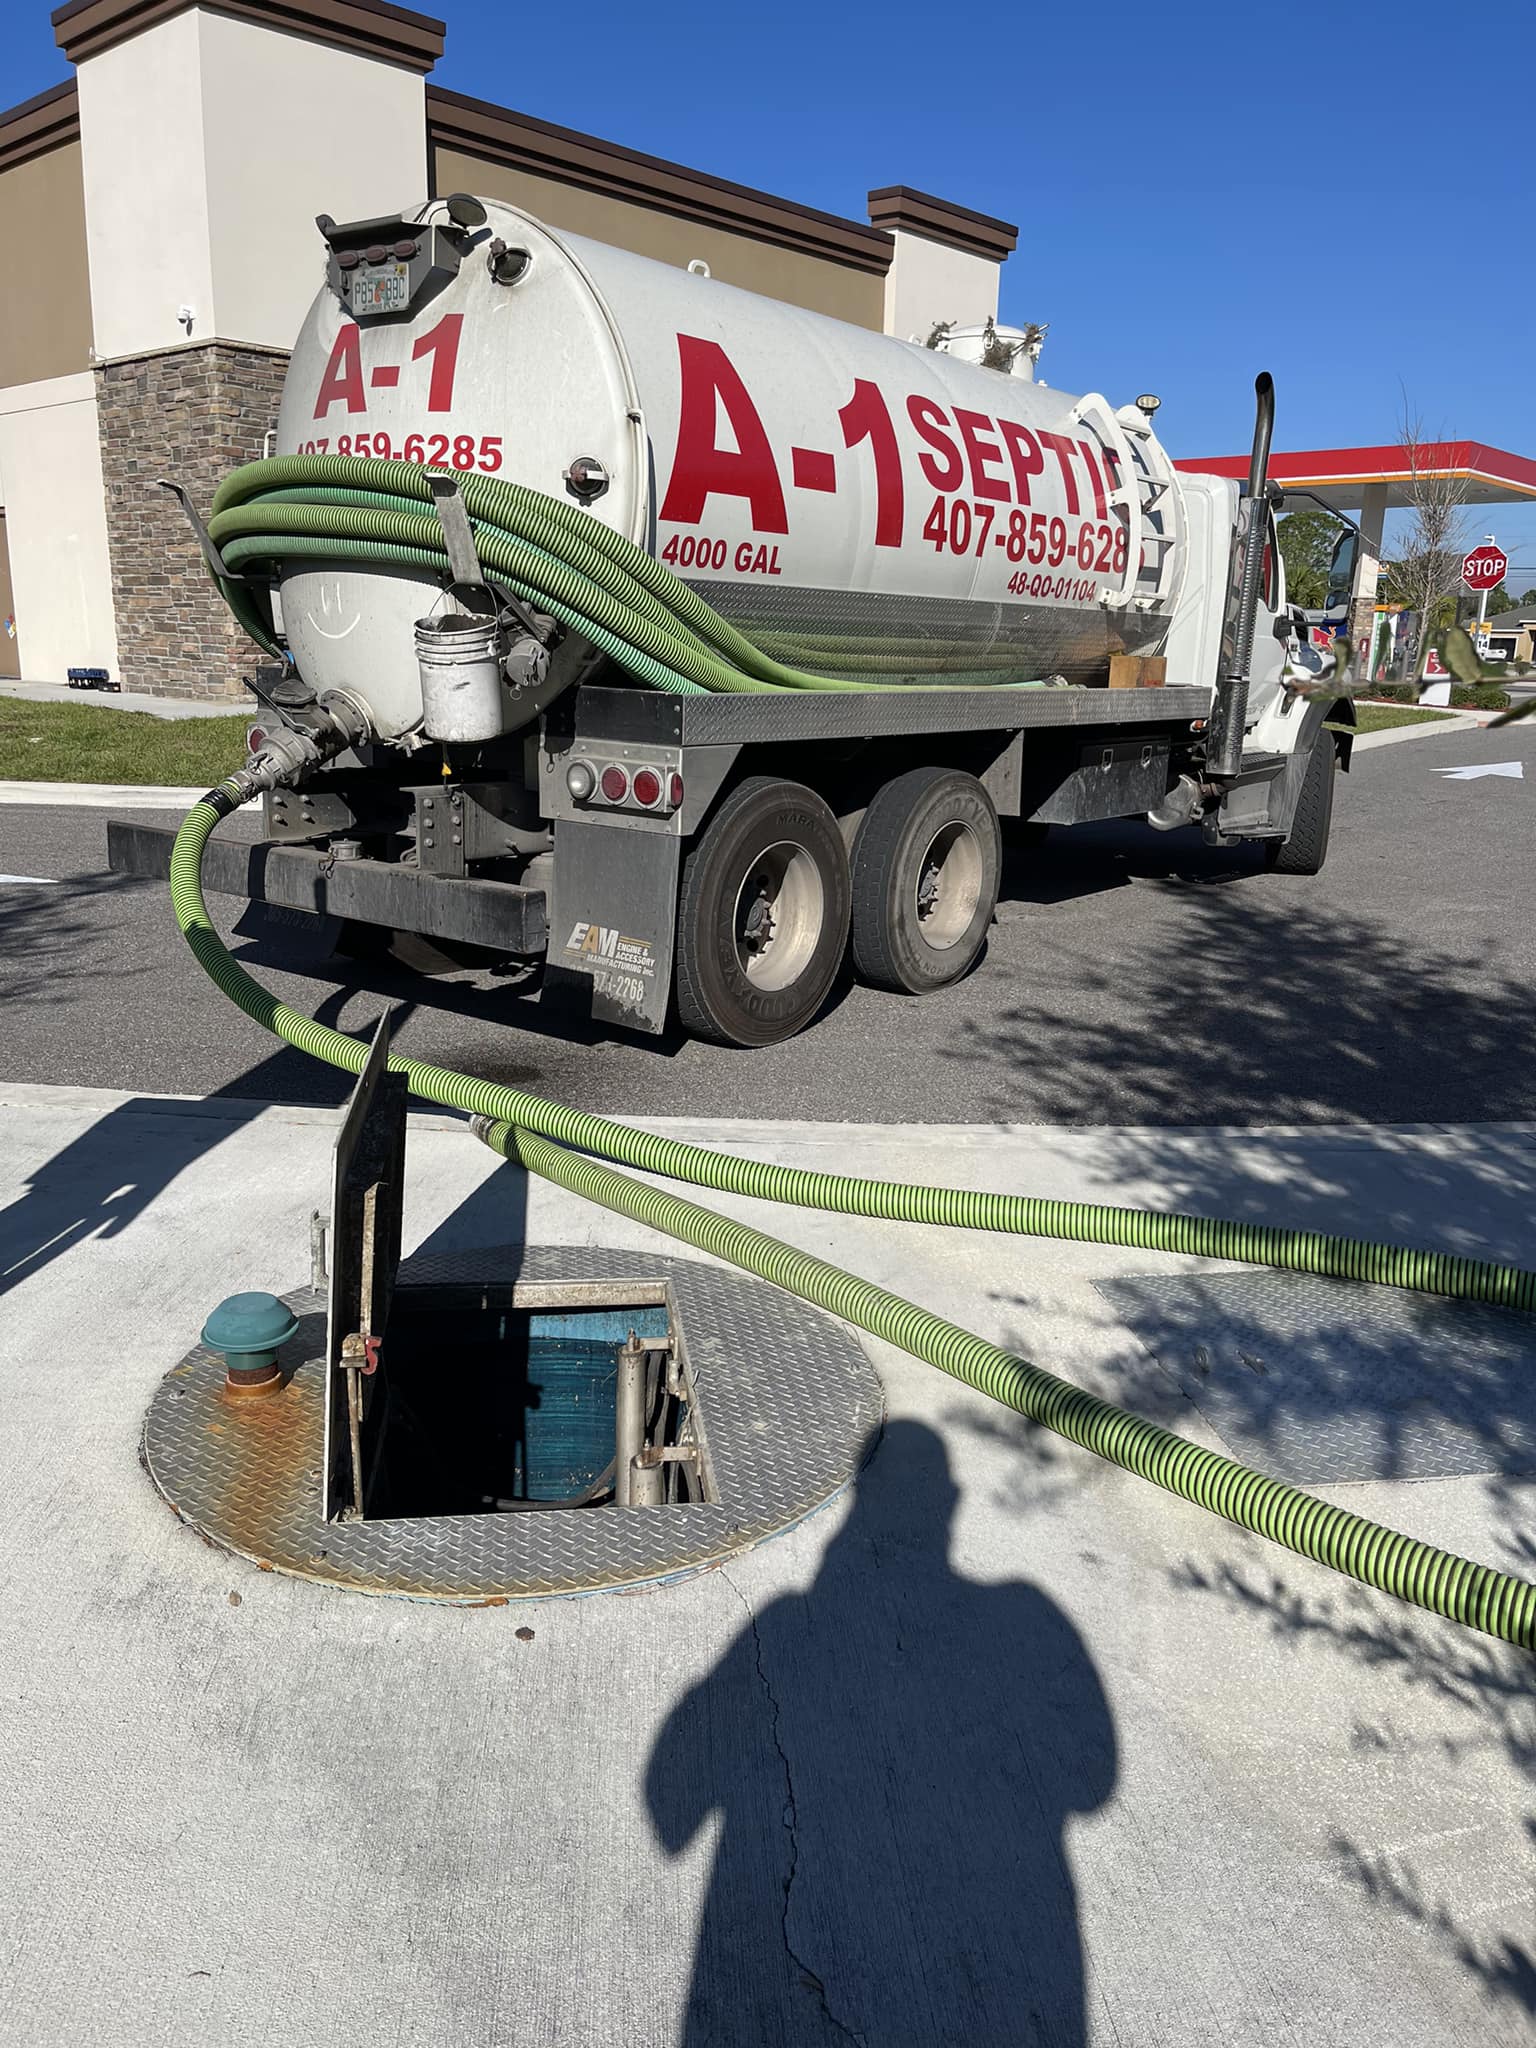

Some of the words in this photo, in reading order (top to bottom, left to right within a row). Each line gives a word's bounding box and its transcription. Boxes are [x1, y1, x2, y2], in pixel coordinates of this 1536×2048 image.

[313, 313, 465, 420] A-1
[658, 333, 904, 548] A-1
[662, 534, 728, 570] 4000
[734, 542, 782, 575] GAL
[922, 495, 1146, 574] 407-859-628
[1465, 559, 1505, 577] STOP
[565, 921, 620, 958] EAM
[615, 952, 656, 967] ACCESSORY
